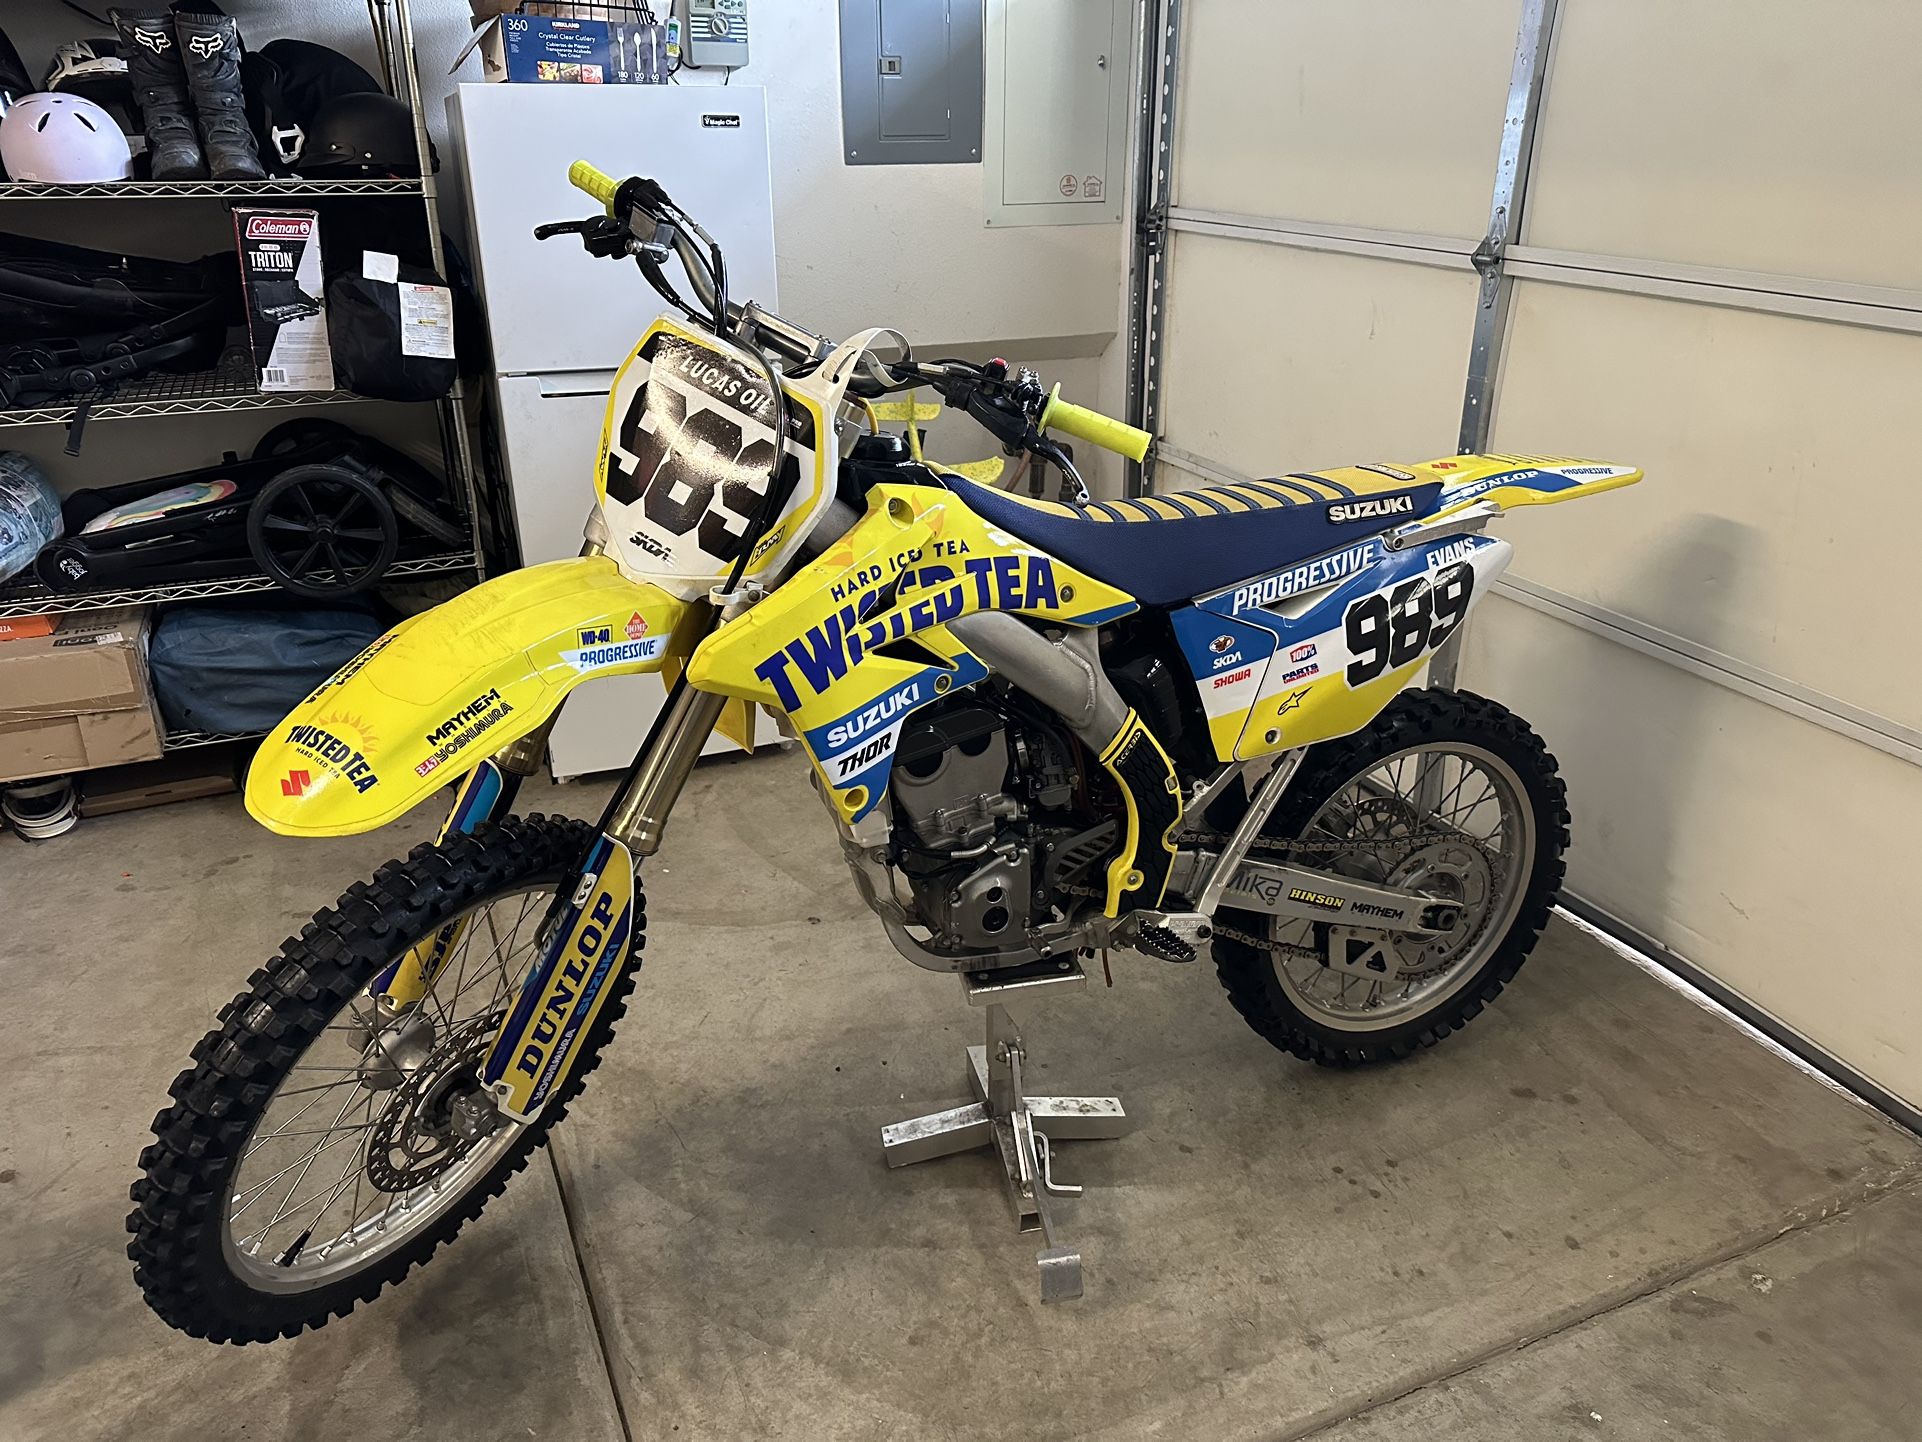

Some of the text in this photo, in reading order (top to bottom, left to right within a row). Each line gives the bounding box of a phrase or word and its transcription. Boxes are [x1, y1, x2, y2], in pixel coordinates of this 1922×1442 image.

[507, 18, 528, 32] 360
[538, 32, 558, 41] Crystal
[575, 35, 596, 43] Cutlery
[617, 71, 628, 79] 180
[634, 72, 644, 80] 120
[651, 73, 659, 81] 60
[252, 219, 298, 234] Coleman
[248, 251, 293, 268] TRITON
[679, 355, 775, 414] LUCAS OIL
[605, 381, 801, 564] 989
[1560, 467, 1614, 475] PROGRESSIVE
[1464, 470, 1539, 496] DUNLOP
[1329, 495, 1413, 521] SUZUKI
[1426, 537, 1477, 571] EVANS
[830, 565, 884, 603] HARD
[932, 539, 971, 559] TEA
[1232, 543, 1375, 616] PROGRESSIVE
[626, 623, 646, 634] HOME
[1346, 560, 1475, 687] 989
[581, 628, 611, 645] WD-40
[754, 556, 1060, 714] TWISTED TEA
[579, 640, 656, 668] PROGRESSIVE
[1212, 651, 1242, 669] SKDA
[1291, 645, 1316, 662] 100%
[1213, 668, 1251, 689] SHOWA
[1282, 663, 1319, 681] PARTS
[1283, 668, 1320, 684] UNLIMITED
[426, 688, 501, 746] MAYHEM
[827, 682, 921, 749] SUZUKI
[434, 702, 514, 763] YOSHIMURA
[285, 725, 379, 794] TWISTED TEA
[295, 747, 313, 758] HARD
[313, 756, 329, 768] ICED
[837, 731, 893, 777] THOR
[1289, 888, 1345, 907] HINSON
[1351, 902, 1405, 920] MAYHEM
[516, 891, 614, 1079] DUNLOP
[577, 943, 620, 1016] SUZUKI
